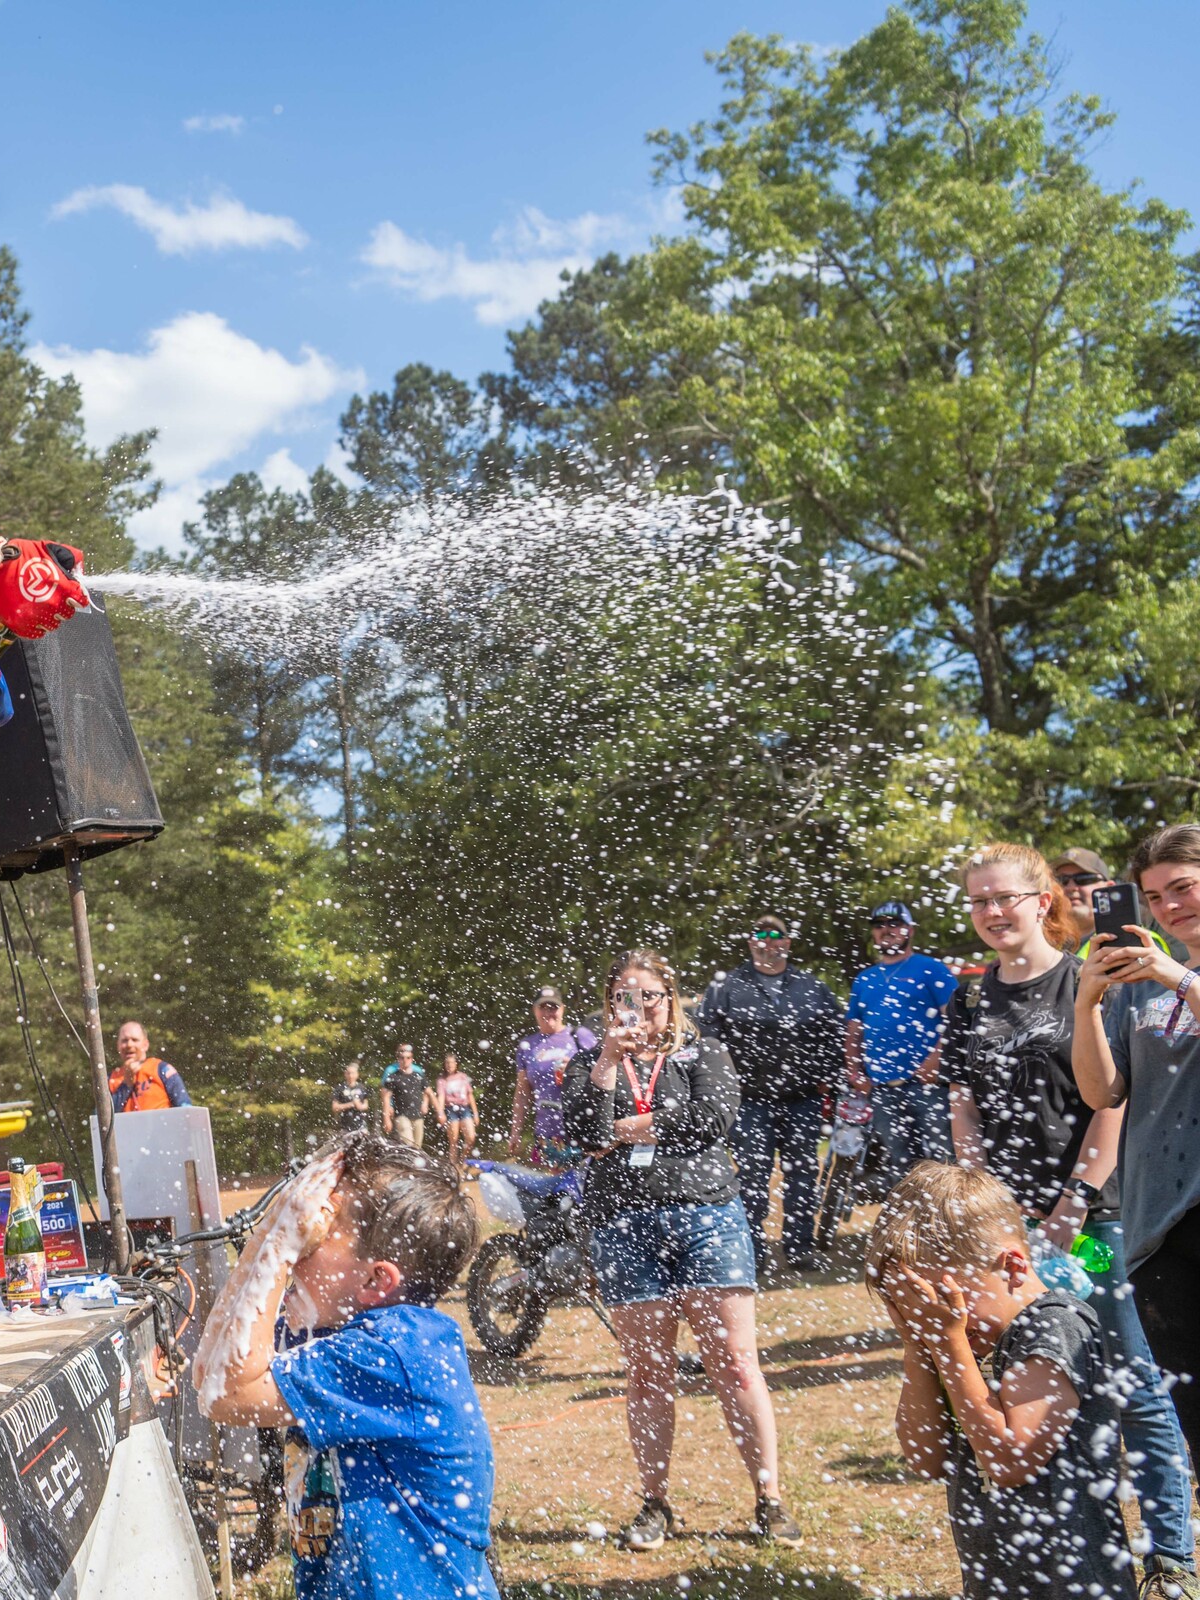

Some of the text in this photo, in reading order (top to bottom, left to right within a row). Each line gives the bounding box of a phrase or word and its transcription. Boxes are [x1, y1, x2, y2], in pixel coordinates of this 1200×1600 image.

[42, 1218, 66, 1231] 500
[46, 1201, 64, 1210] 2021
[59, 1346, 110, 1411] VICTORY
[35, 1445, 81, 1510] turbo
